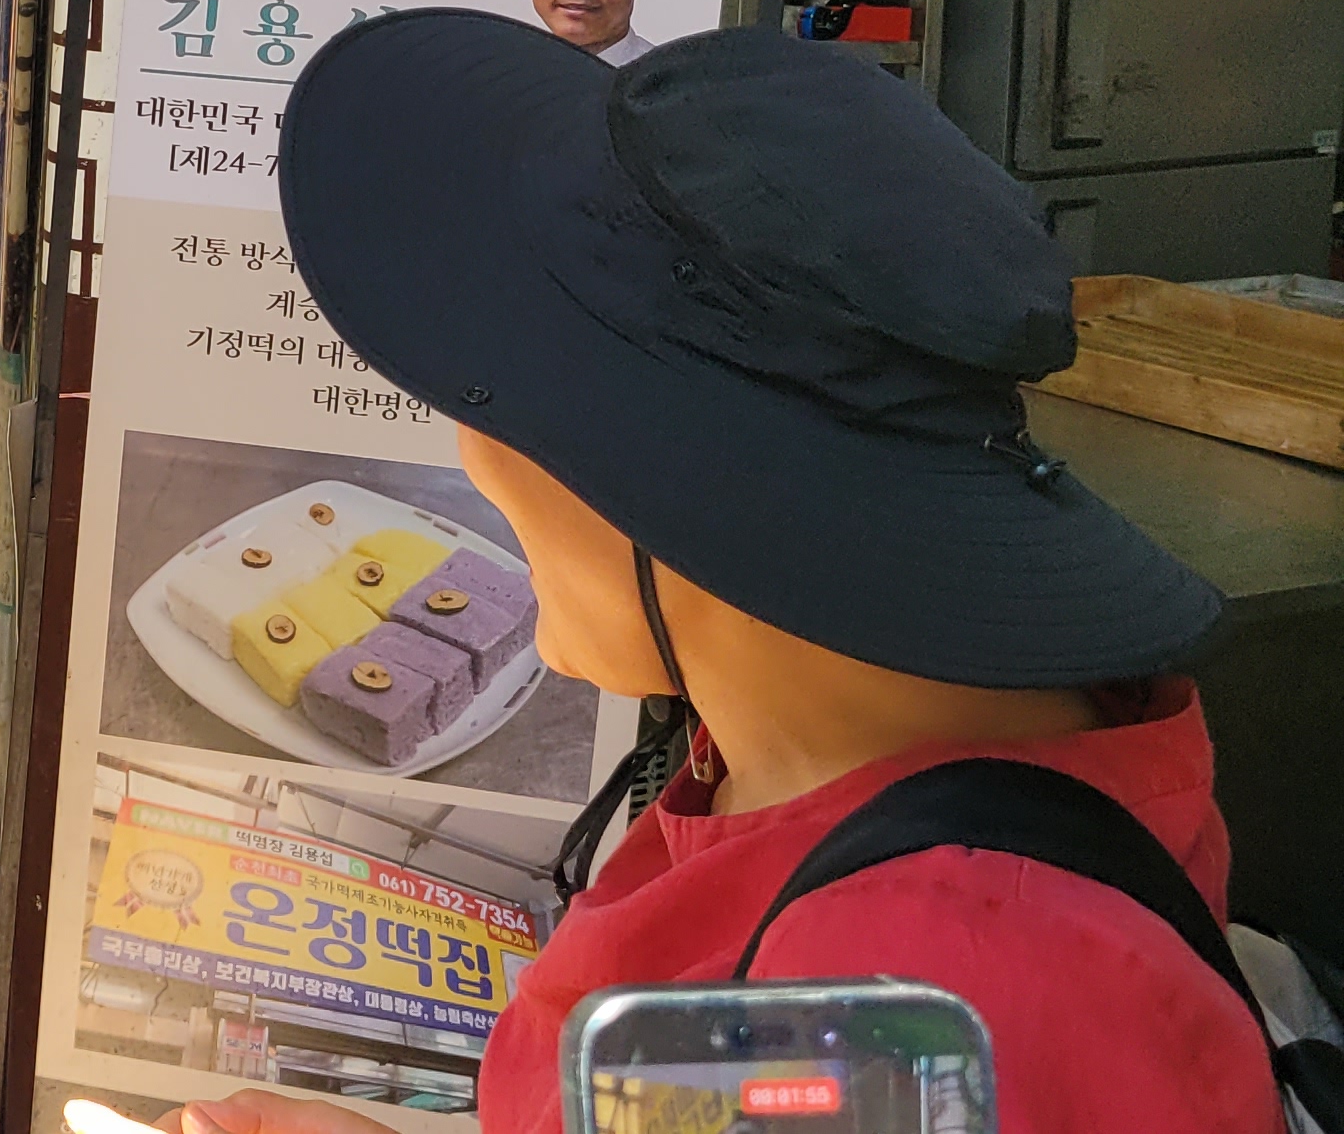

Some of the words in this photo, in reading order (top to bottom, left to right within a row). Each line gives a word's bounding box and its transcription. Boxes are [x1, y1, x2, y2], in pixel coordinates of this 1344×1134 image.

[135, 96, 265, 137] 대한민국
[170, 234, 231, 268] 전통
[186, 326, 305, 365] 기정떡의
[313, 385, 432, 424] 대한명인
[235, 830, 284, 854] 떡명장
[289, 841, 334, 867] 김용섭
[378, 872, 416, 897] 061)
[419, 879, 530, 935] 752-7354
[223, 881, 493, 1001] 온정떡집
